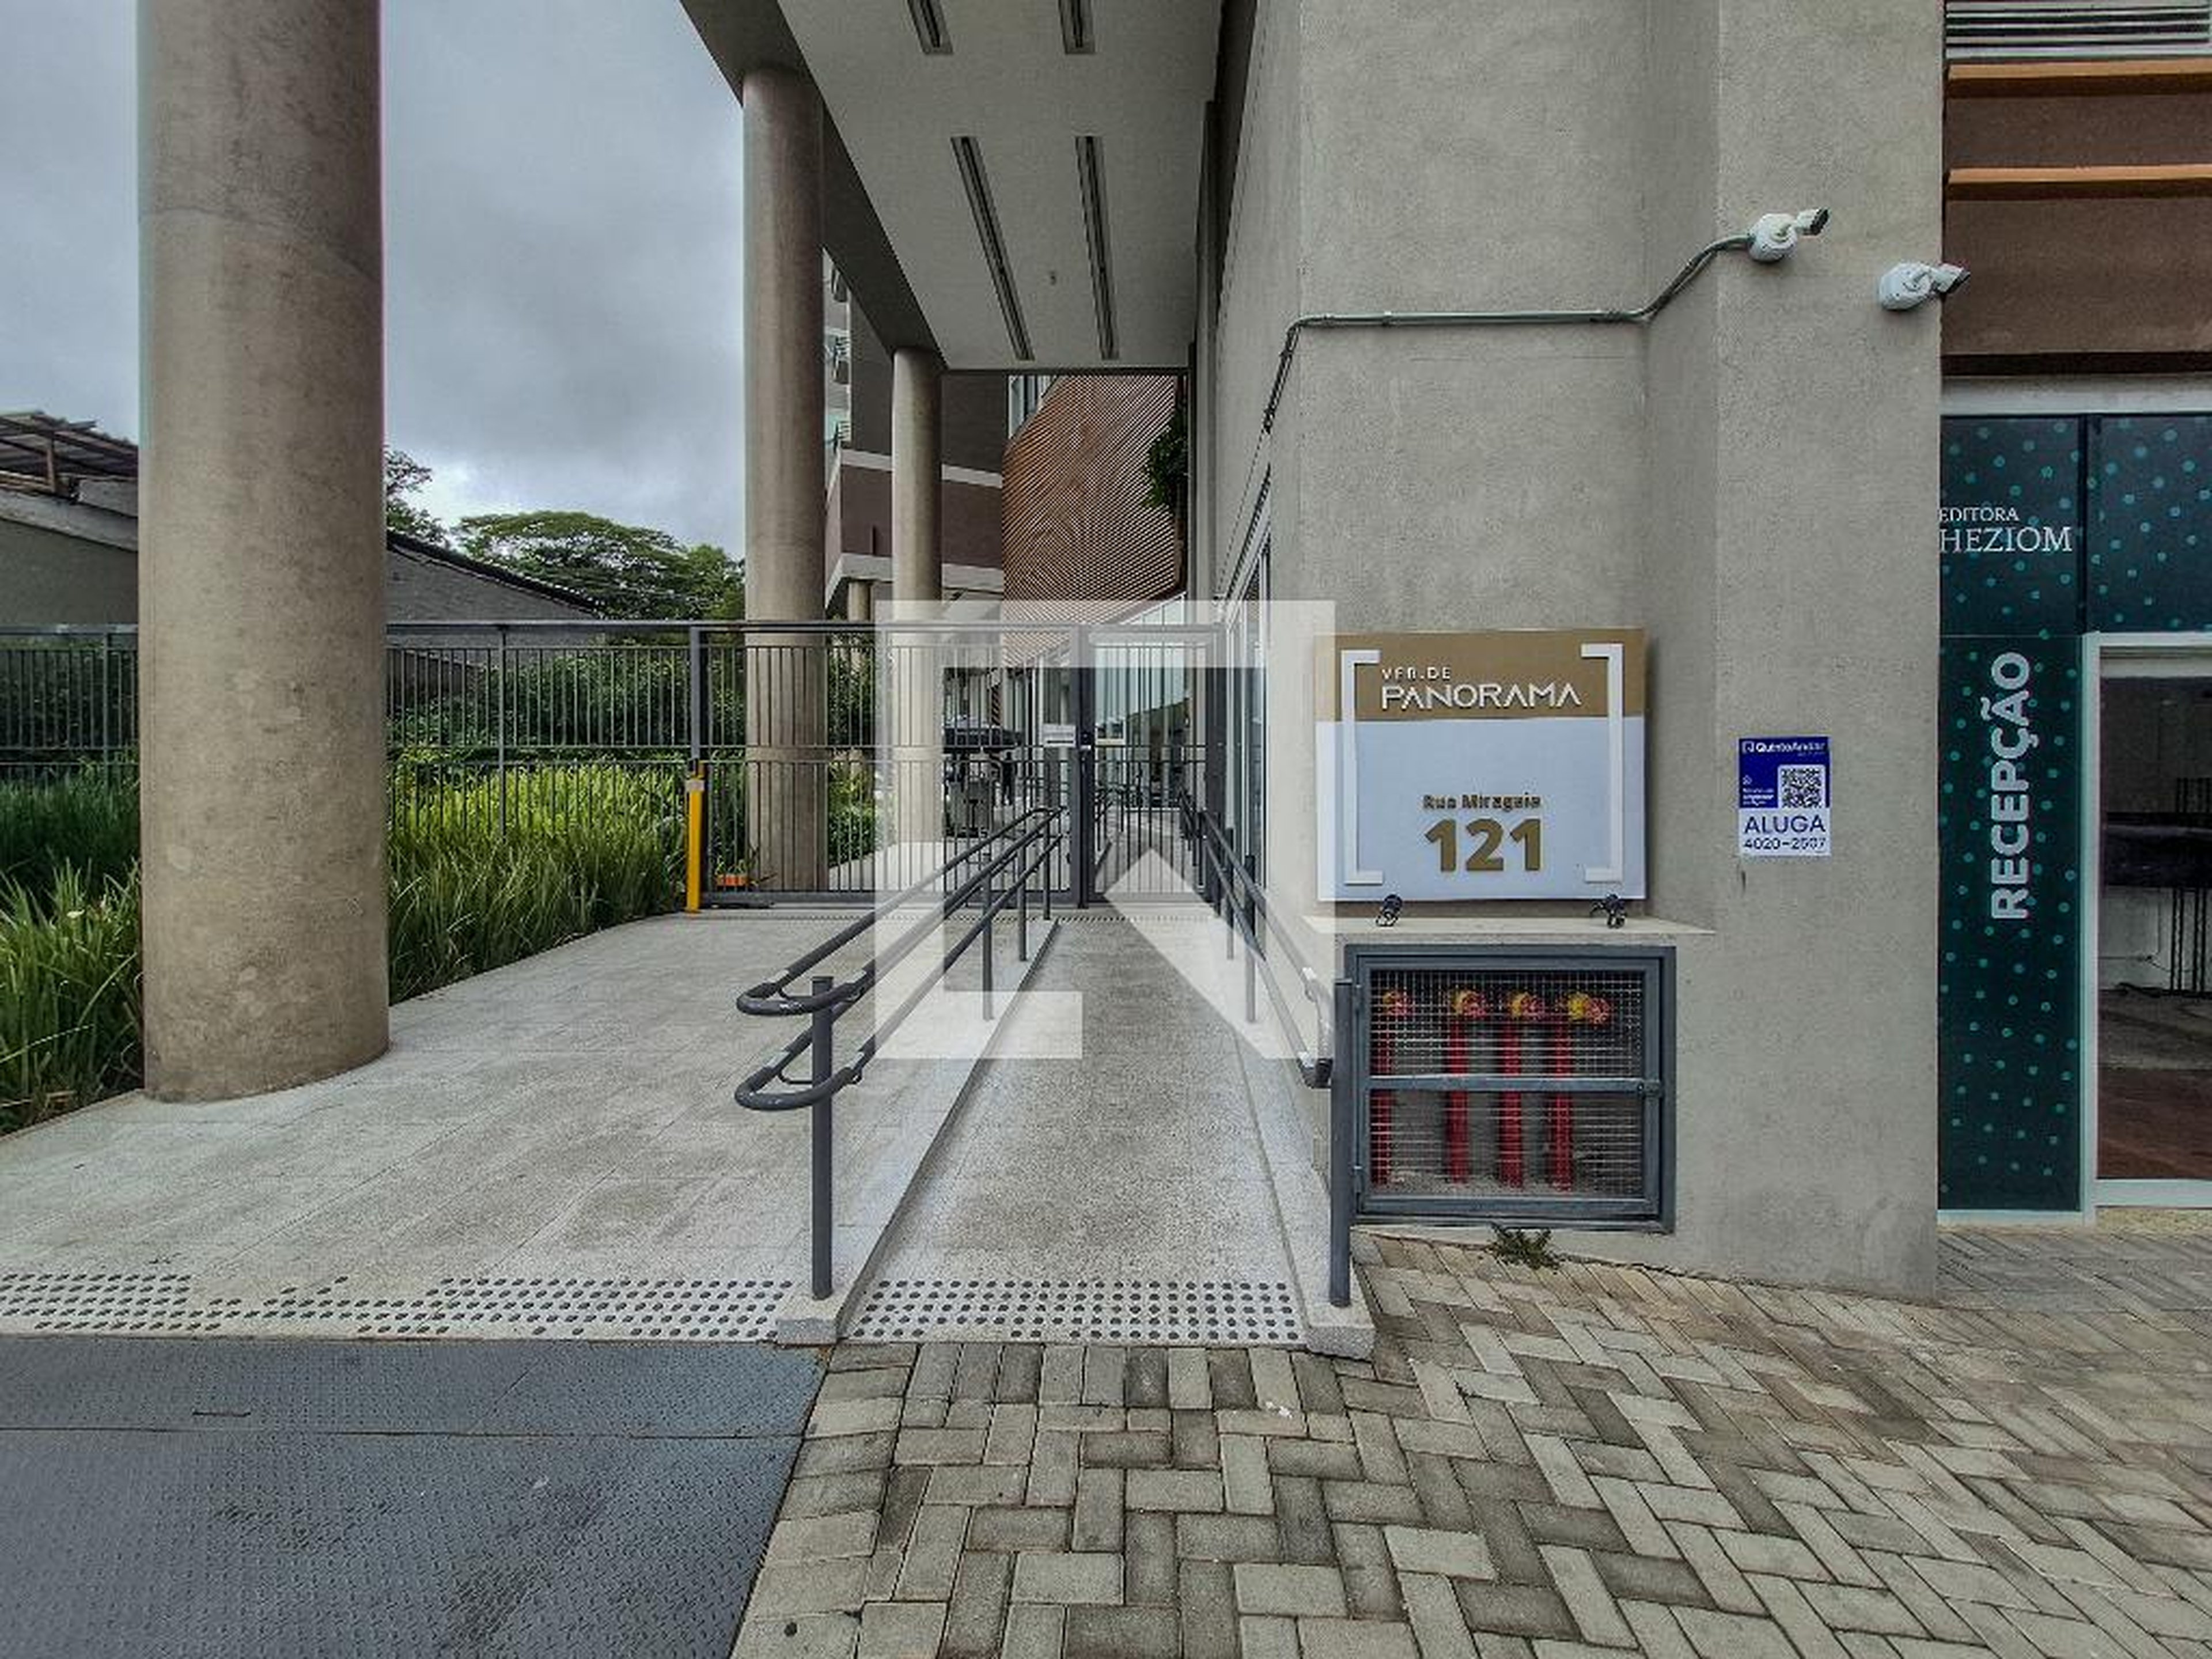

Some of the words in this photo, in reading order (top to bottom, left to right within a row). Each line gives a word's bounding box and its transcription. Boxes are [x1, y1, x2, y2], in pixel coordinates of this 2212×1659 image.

[1939, 507, 2019, 521] EDITORA
[1940, 527, 2073, 552] HEZIOM
[1382, 683, 1582, 710] PANORAMA
[1980, 652, 2039, 919] RECEPÇÃO
[1423, 794, 1457, 809] Rua
[1744, 815, 1826, 834] ALUGA
[1425, 819, 1541, 872] 121
